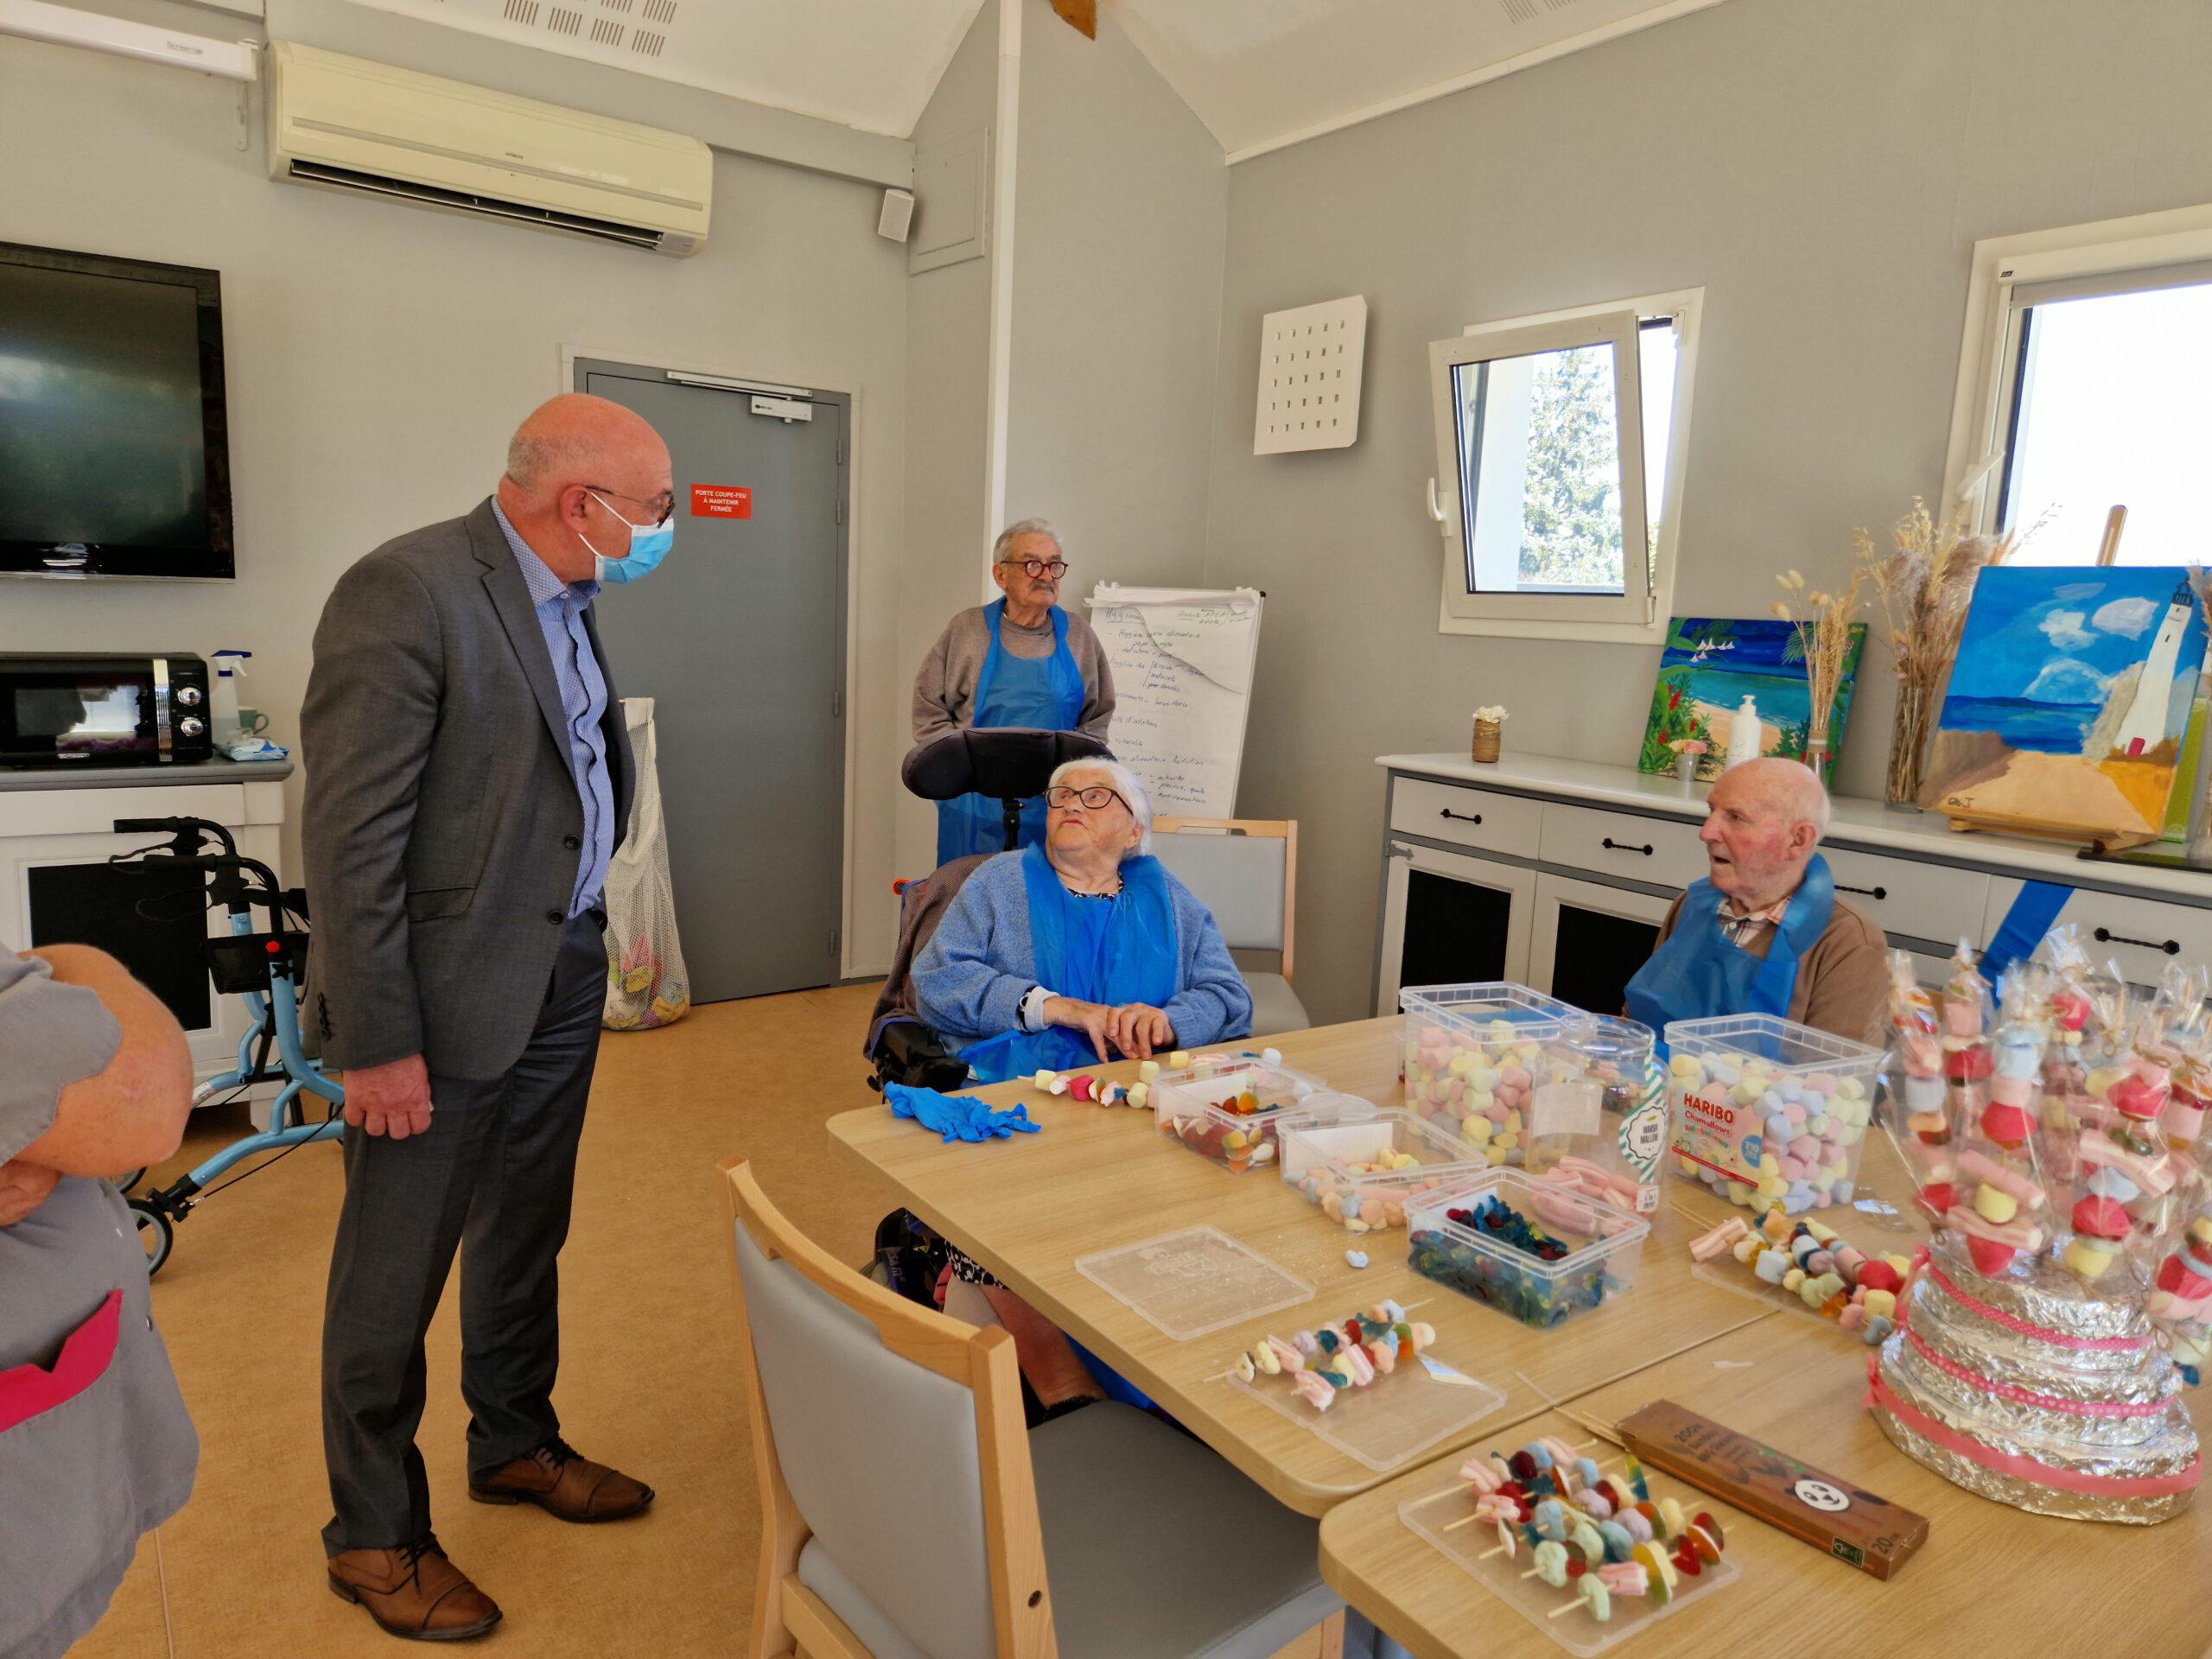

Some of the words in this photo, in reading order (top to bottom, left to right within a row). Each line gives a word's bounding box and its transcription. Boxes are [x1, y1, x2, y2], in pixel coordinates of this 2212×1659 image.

[1683, 1092, 1734, 1124] HARIBO
[1685, 1109, 1731, 1135] Chamallows
[1643, 1123, 1658, 1135] MARSH
[1640, 1133, 1658, 1144] MALLOW
[1744, 1141, 1759, 1153] 210
